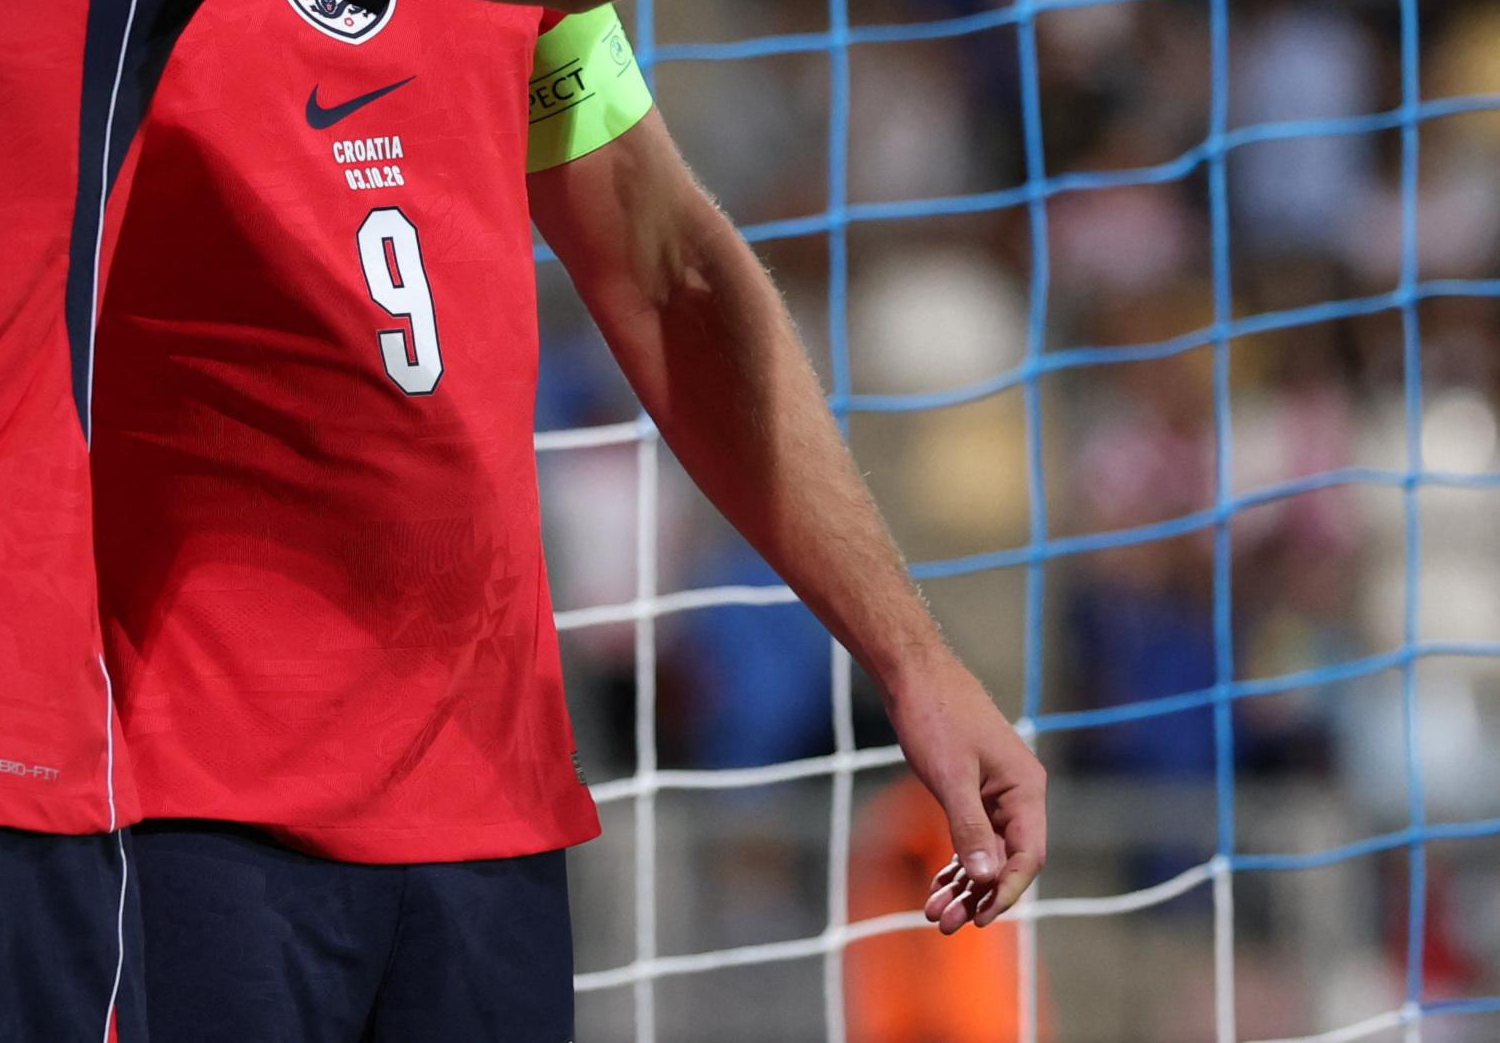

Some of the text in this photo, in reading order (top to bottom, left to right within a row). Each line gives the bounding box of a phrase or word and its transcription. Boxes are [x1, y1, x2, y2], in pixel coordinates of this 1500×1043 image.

[332, 135, 404, 164] CROATIA
[344, 165, 405, 191] 03.10.26
[356, 206, 445, 396] 9
